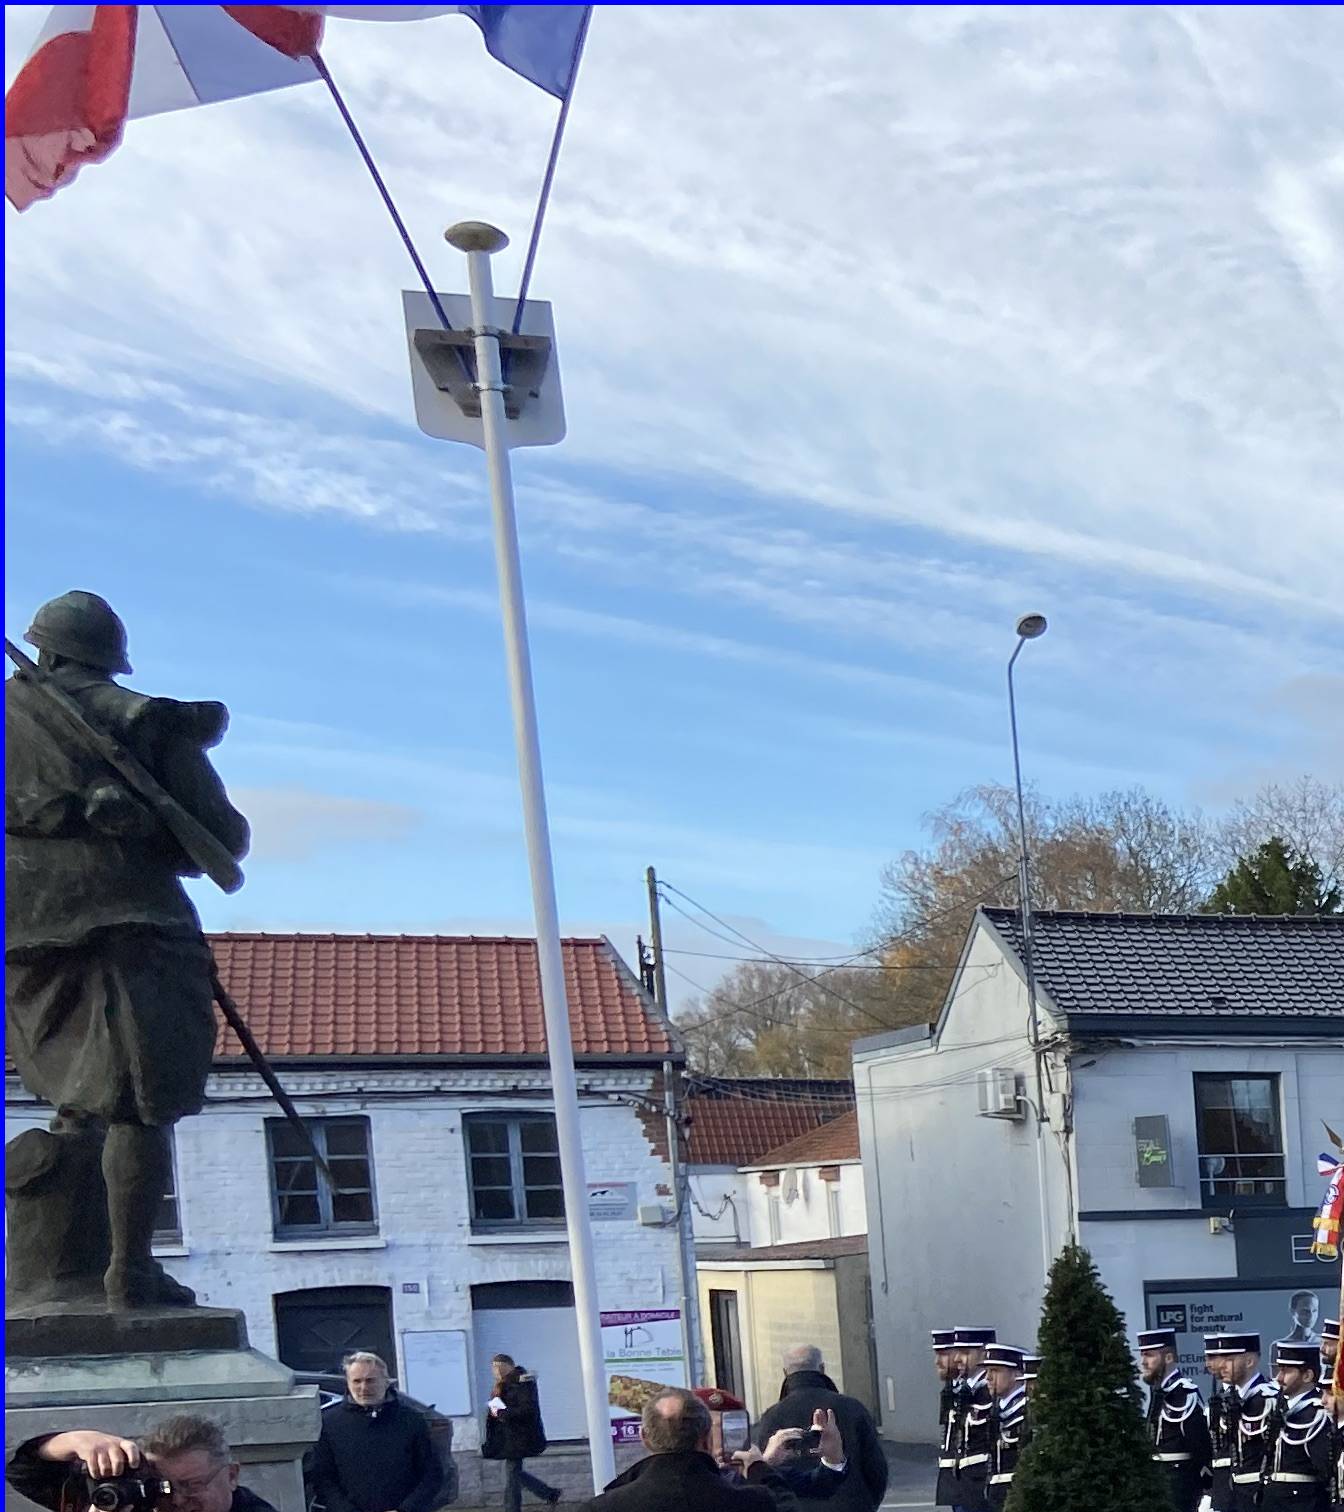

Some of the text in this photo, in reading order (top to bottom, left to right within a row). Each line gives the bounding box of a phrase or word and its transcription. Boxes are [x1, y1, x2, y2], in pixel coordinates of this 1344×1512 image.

[1160, 1303, 1214, 1323] LPG fight
[1190, 1312, 1243, 1323] for natural
[1190, 1324, 1226, 1333] beauty
